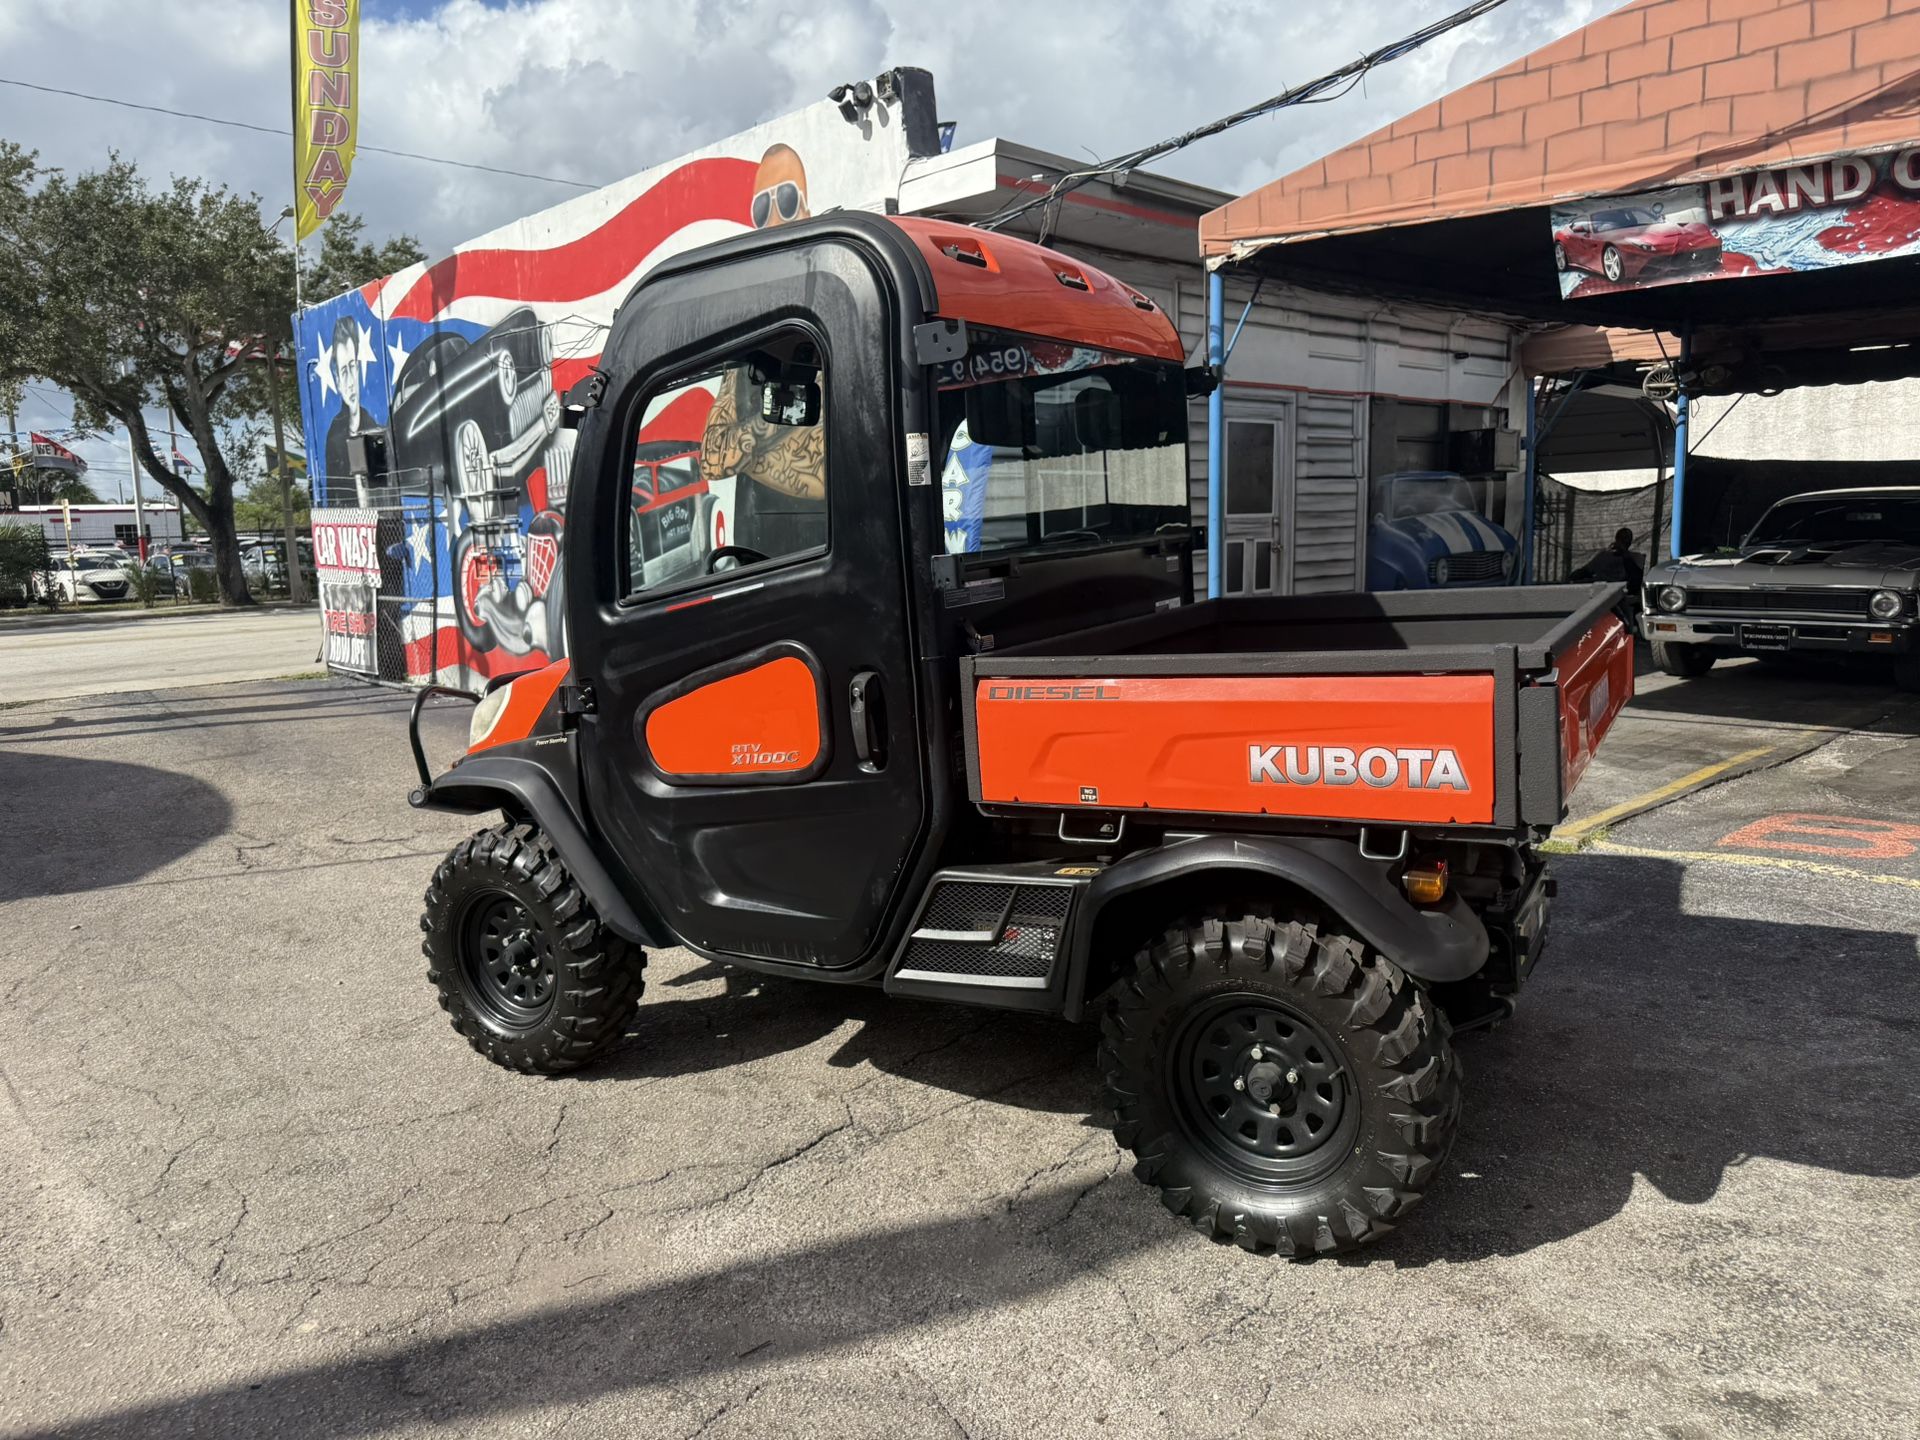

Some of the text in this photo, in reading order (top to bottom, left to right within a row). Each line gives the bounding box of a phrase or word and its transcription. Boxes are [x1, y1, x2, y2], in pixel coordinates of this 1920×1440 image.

[303, 0, 351, 219] SUNDAY
[1708, 156, 1873, 221] HAND
[661, 506, 689, 528] BIG BOY
[314, 526, 380, 570] CAR WASH
[989, 685, 1121, 700] DIESEL
[731, 743, 761, 753] RTV
[731, 750, 799, 765] X1100C
[1249, 744, 1469, 791] KUBOTA
